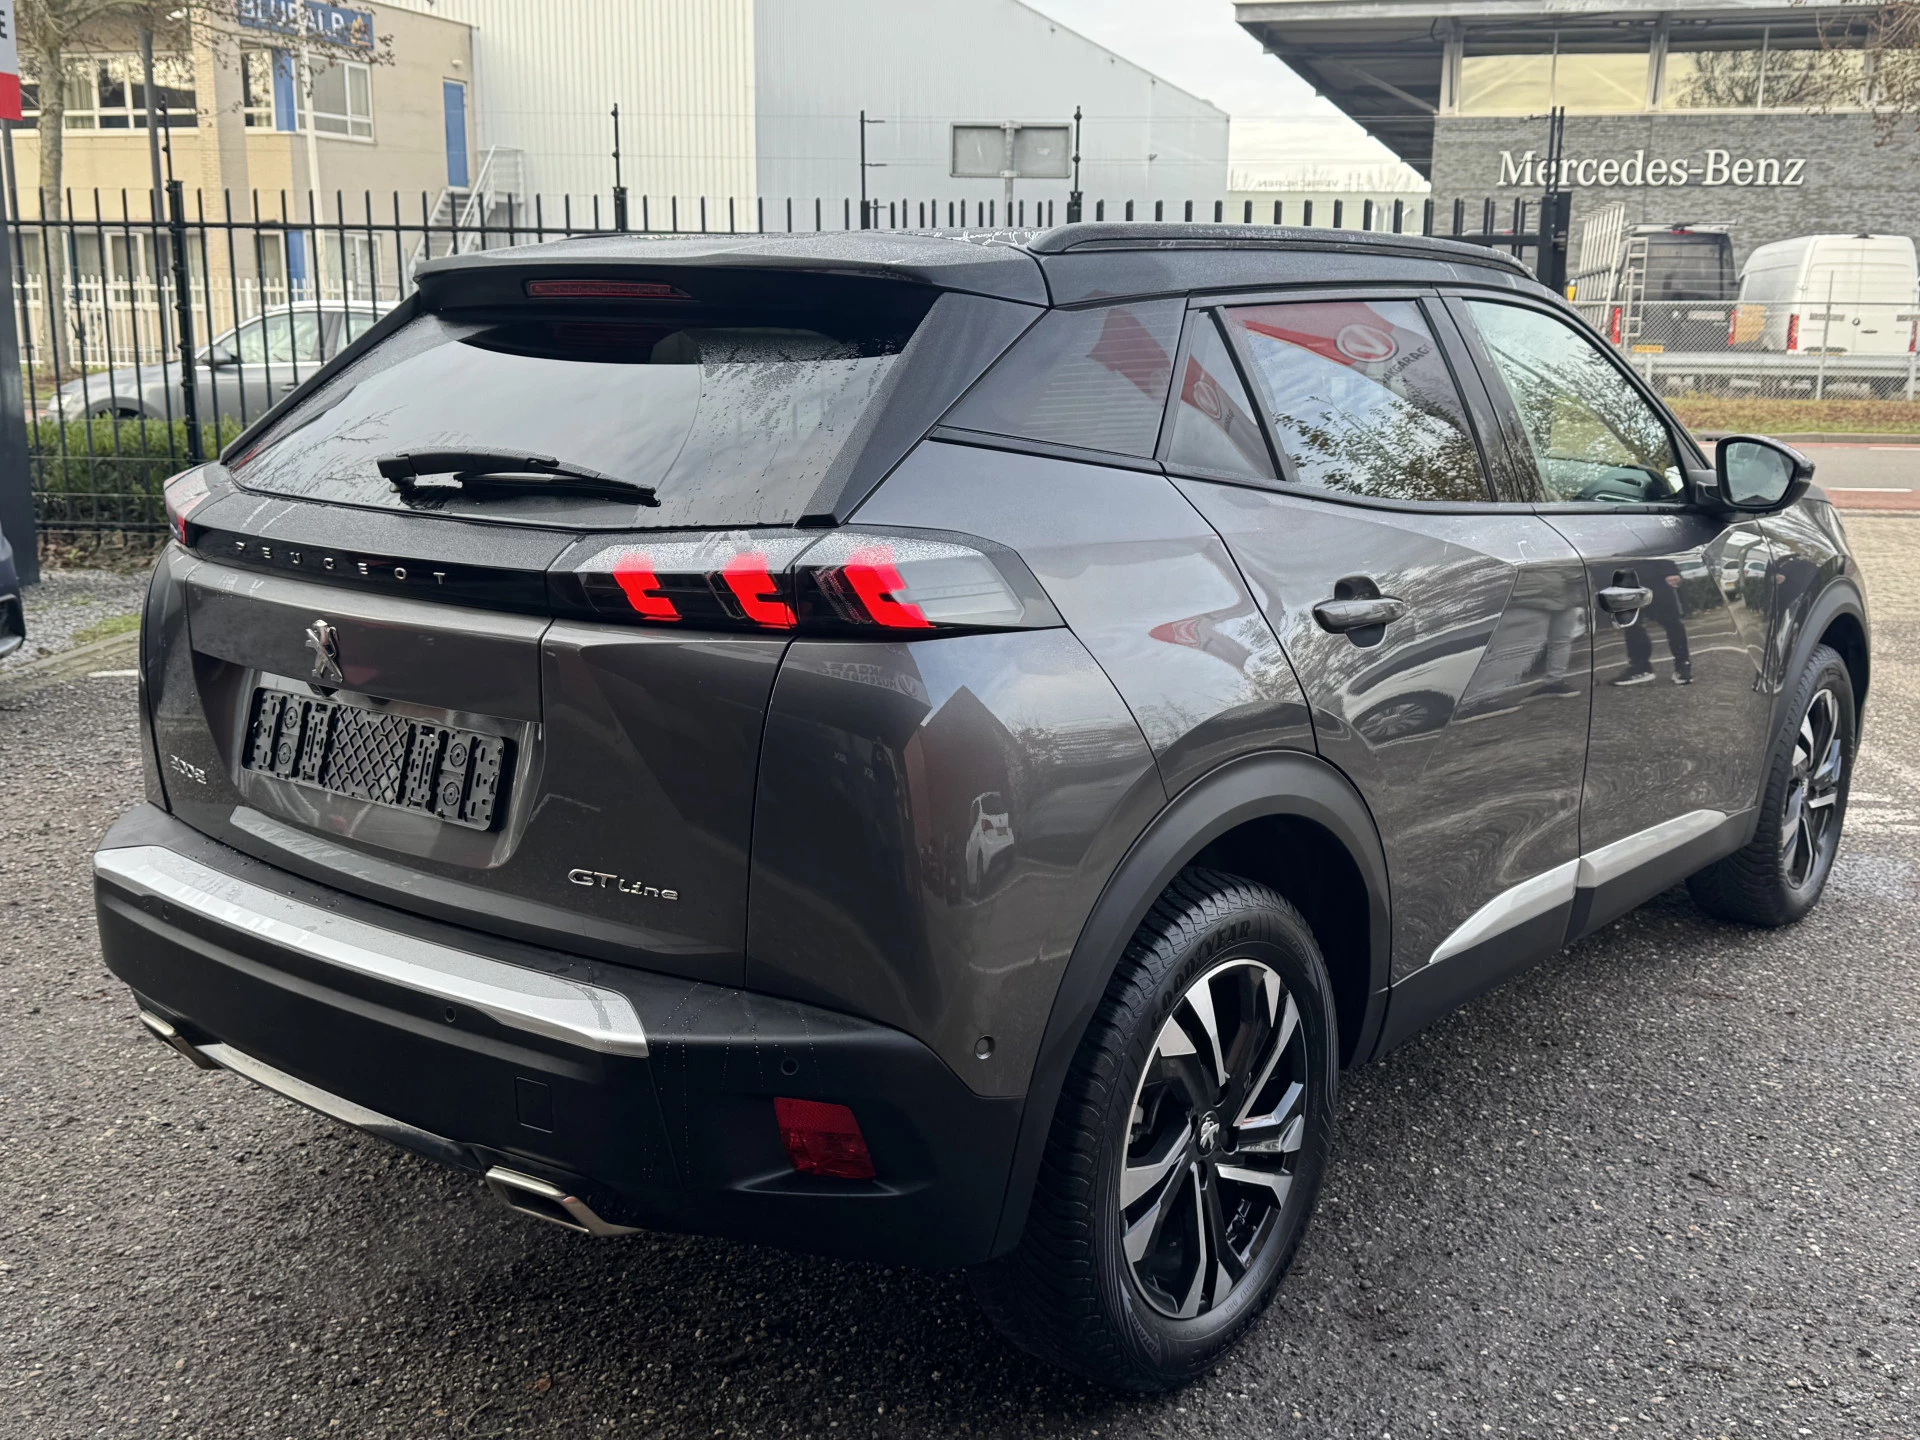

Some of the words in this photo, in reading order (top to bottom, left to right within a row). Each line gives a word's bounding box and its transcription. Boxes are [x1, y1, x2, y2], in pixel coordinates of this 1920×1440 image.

[1495, 148, 1807, 187] Mercedes-Benz
[235, 541, 446, 585] PEUGEOT
[567, 868, 618, 888] GT
